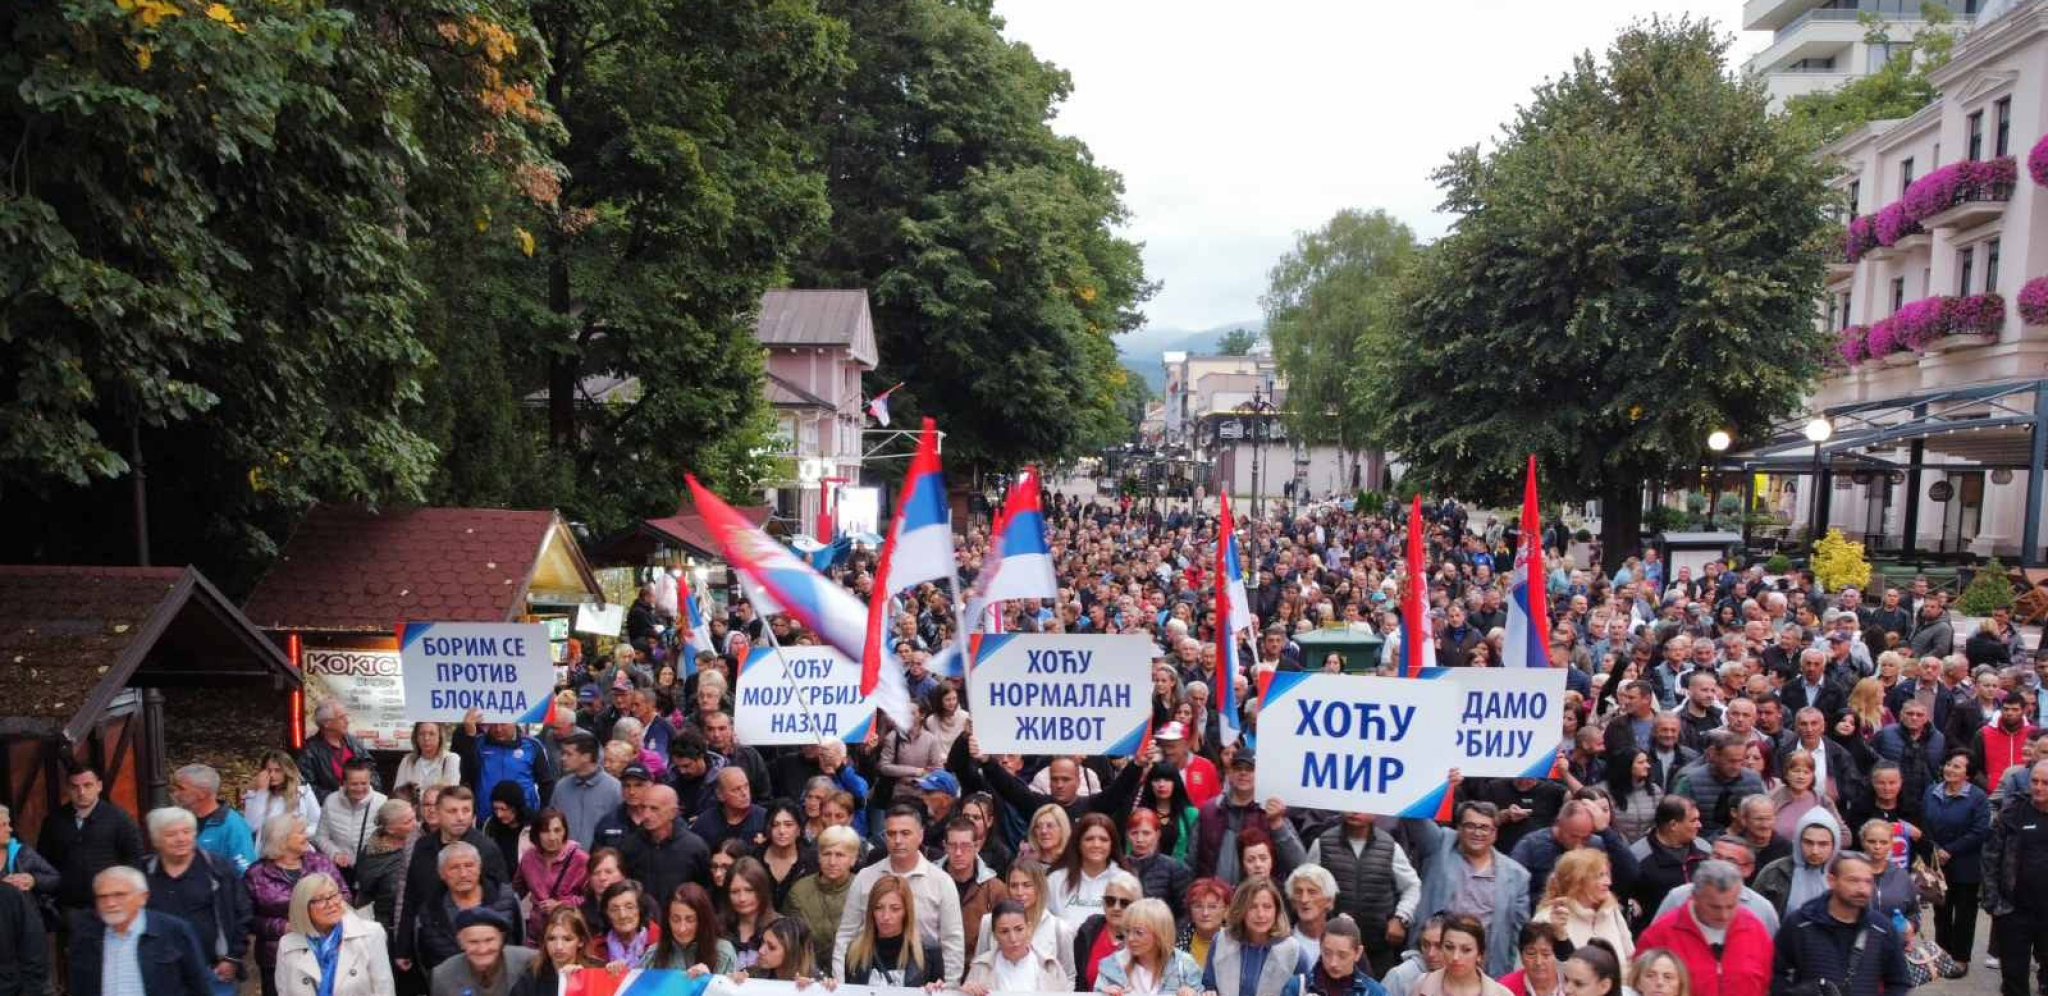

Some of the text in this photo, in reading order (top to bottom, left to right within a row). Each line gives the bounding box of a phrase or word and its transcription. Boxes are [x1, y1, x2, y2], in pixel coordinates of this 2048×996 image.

[423, 637, 526, 657] БОРИМ СЕ
[436, 663, 518, 683] ПРОТИВ
[1027, 649, 1093, 674] ХОЋУ
[431, 690, 528, 713] БЛОКАДА
[743, 687, 794, 705] МОЈУ
[989, 683, 1131, 708] НОРМАЛАН
[1462, 691, 1547, 724] ДАМО
[771, 712, 838, 736] НАЗАД
[1015, 717, 1106, 741] ЖИВОТ
[1295, 699, 1417, 743] ХОЋУ
[1301, 752, 1405, 794] МИР
